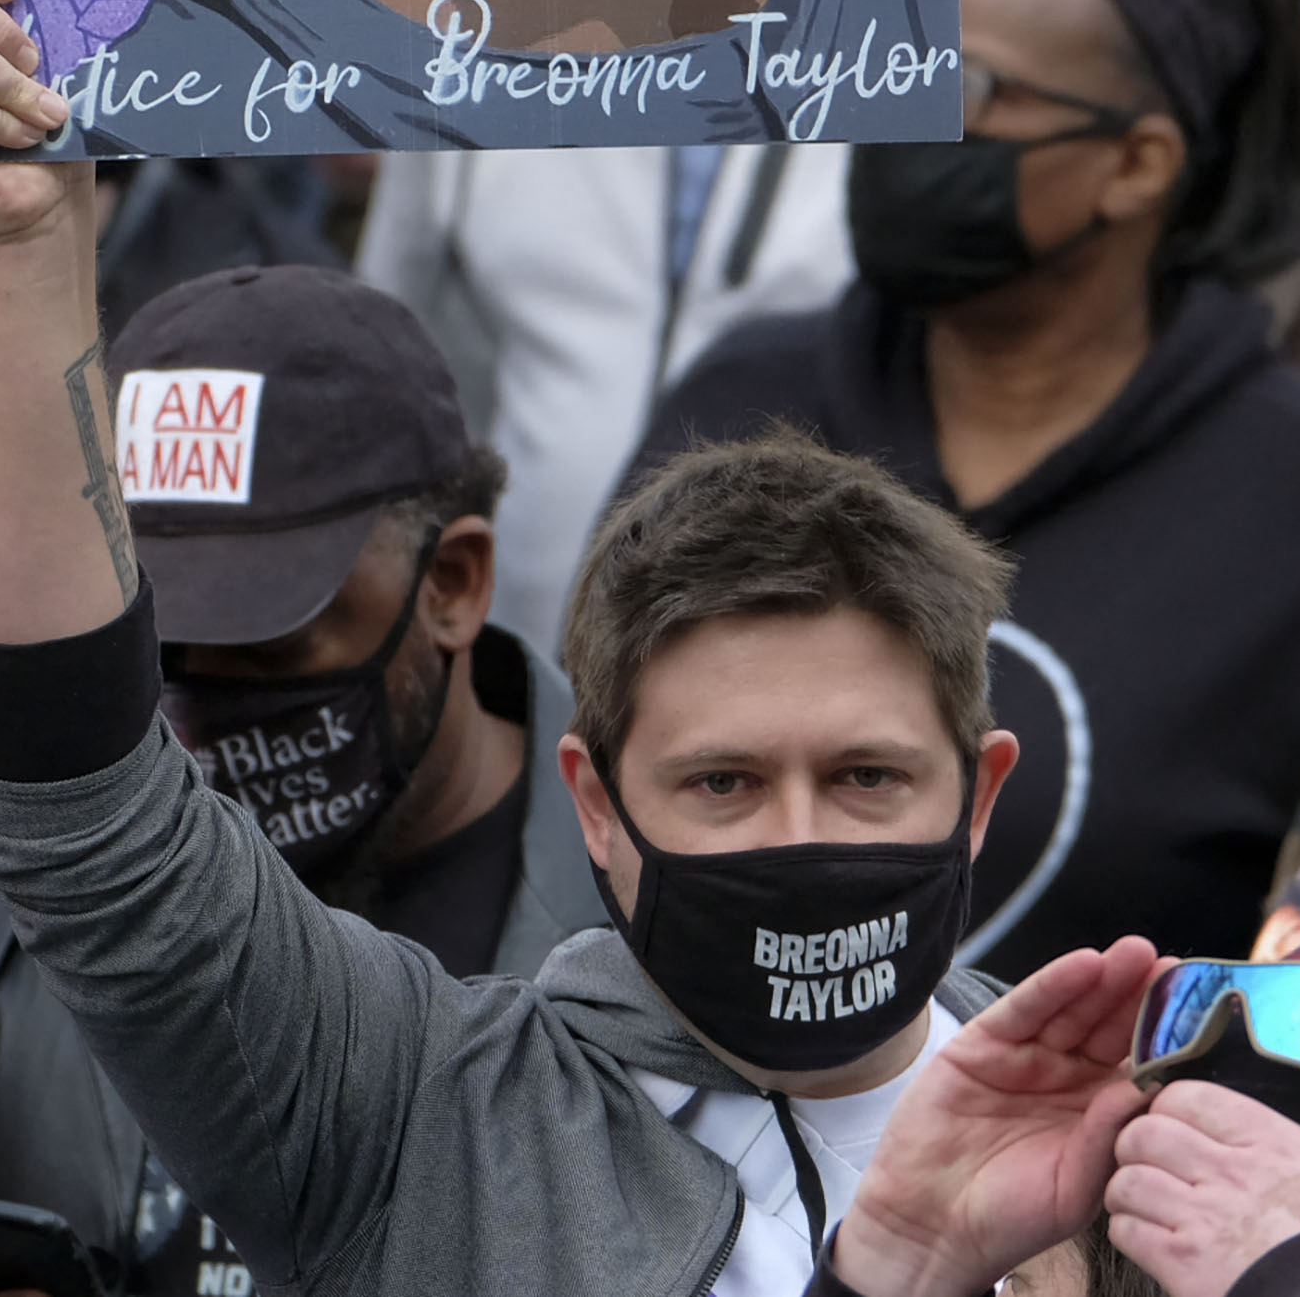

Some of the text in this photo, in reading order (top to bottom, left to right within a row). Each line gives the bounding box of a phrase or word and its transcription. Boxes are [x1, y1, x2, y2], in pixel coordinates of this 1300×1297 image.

[42, 42, 223, 150] stice
[243, 57, 362, 143] for
[727, 11, 958, 142] Taylor
[129, 382, 247, 429] I AM
[121, 439, 242, 493] A MAN
[256, 781, 380, 848] atter.
[753, 910, 908, 975] BREONNA
[767, 959, 896, 1023] TAYLOR
